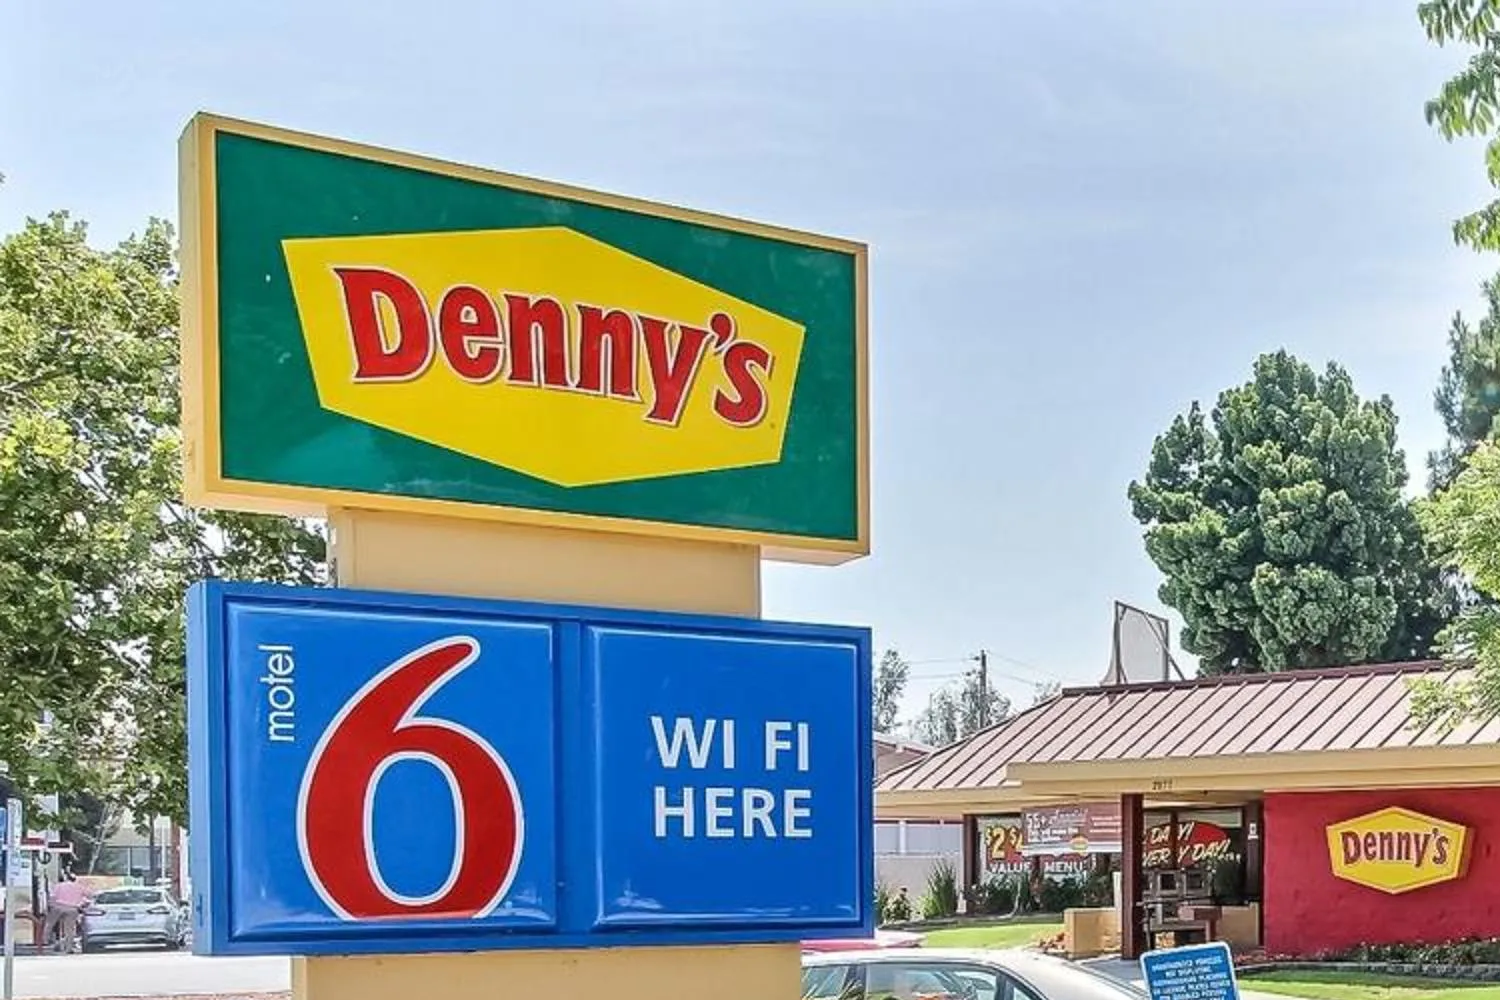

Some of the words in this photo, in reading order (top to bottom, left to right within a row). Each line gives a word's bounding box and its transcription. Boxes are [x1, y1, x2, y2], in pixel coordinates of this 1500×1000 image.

[332, 267, 774, 428] Denny's
[258, 644, 295, 742] motel
[296, 635, 524, 921] 6
[650, 715, 735, 769] WI
[765, 720, 809, 772] FI
[655, 785, 813, 838] HERE
[1340, 827, 1450, 868] Denny's
